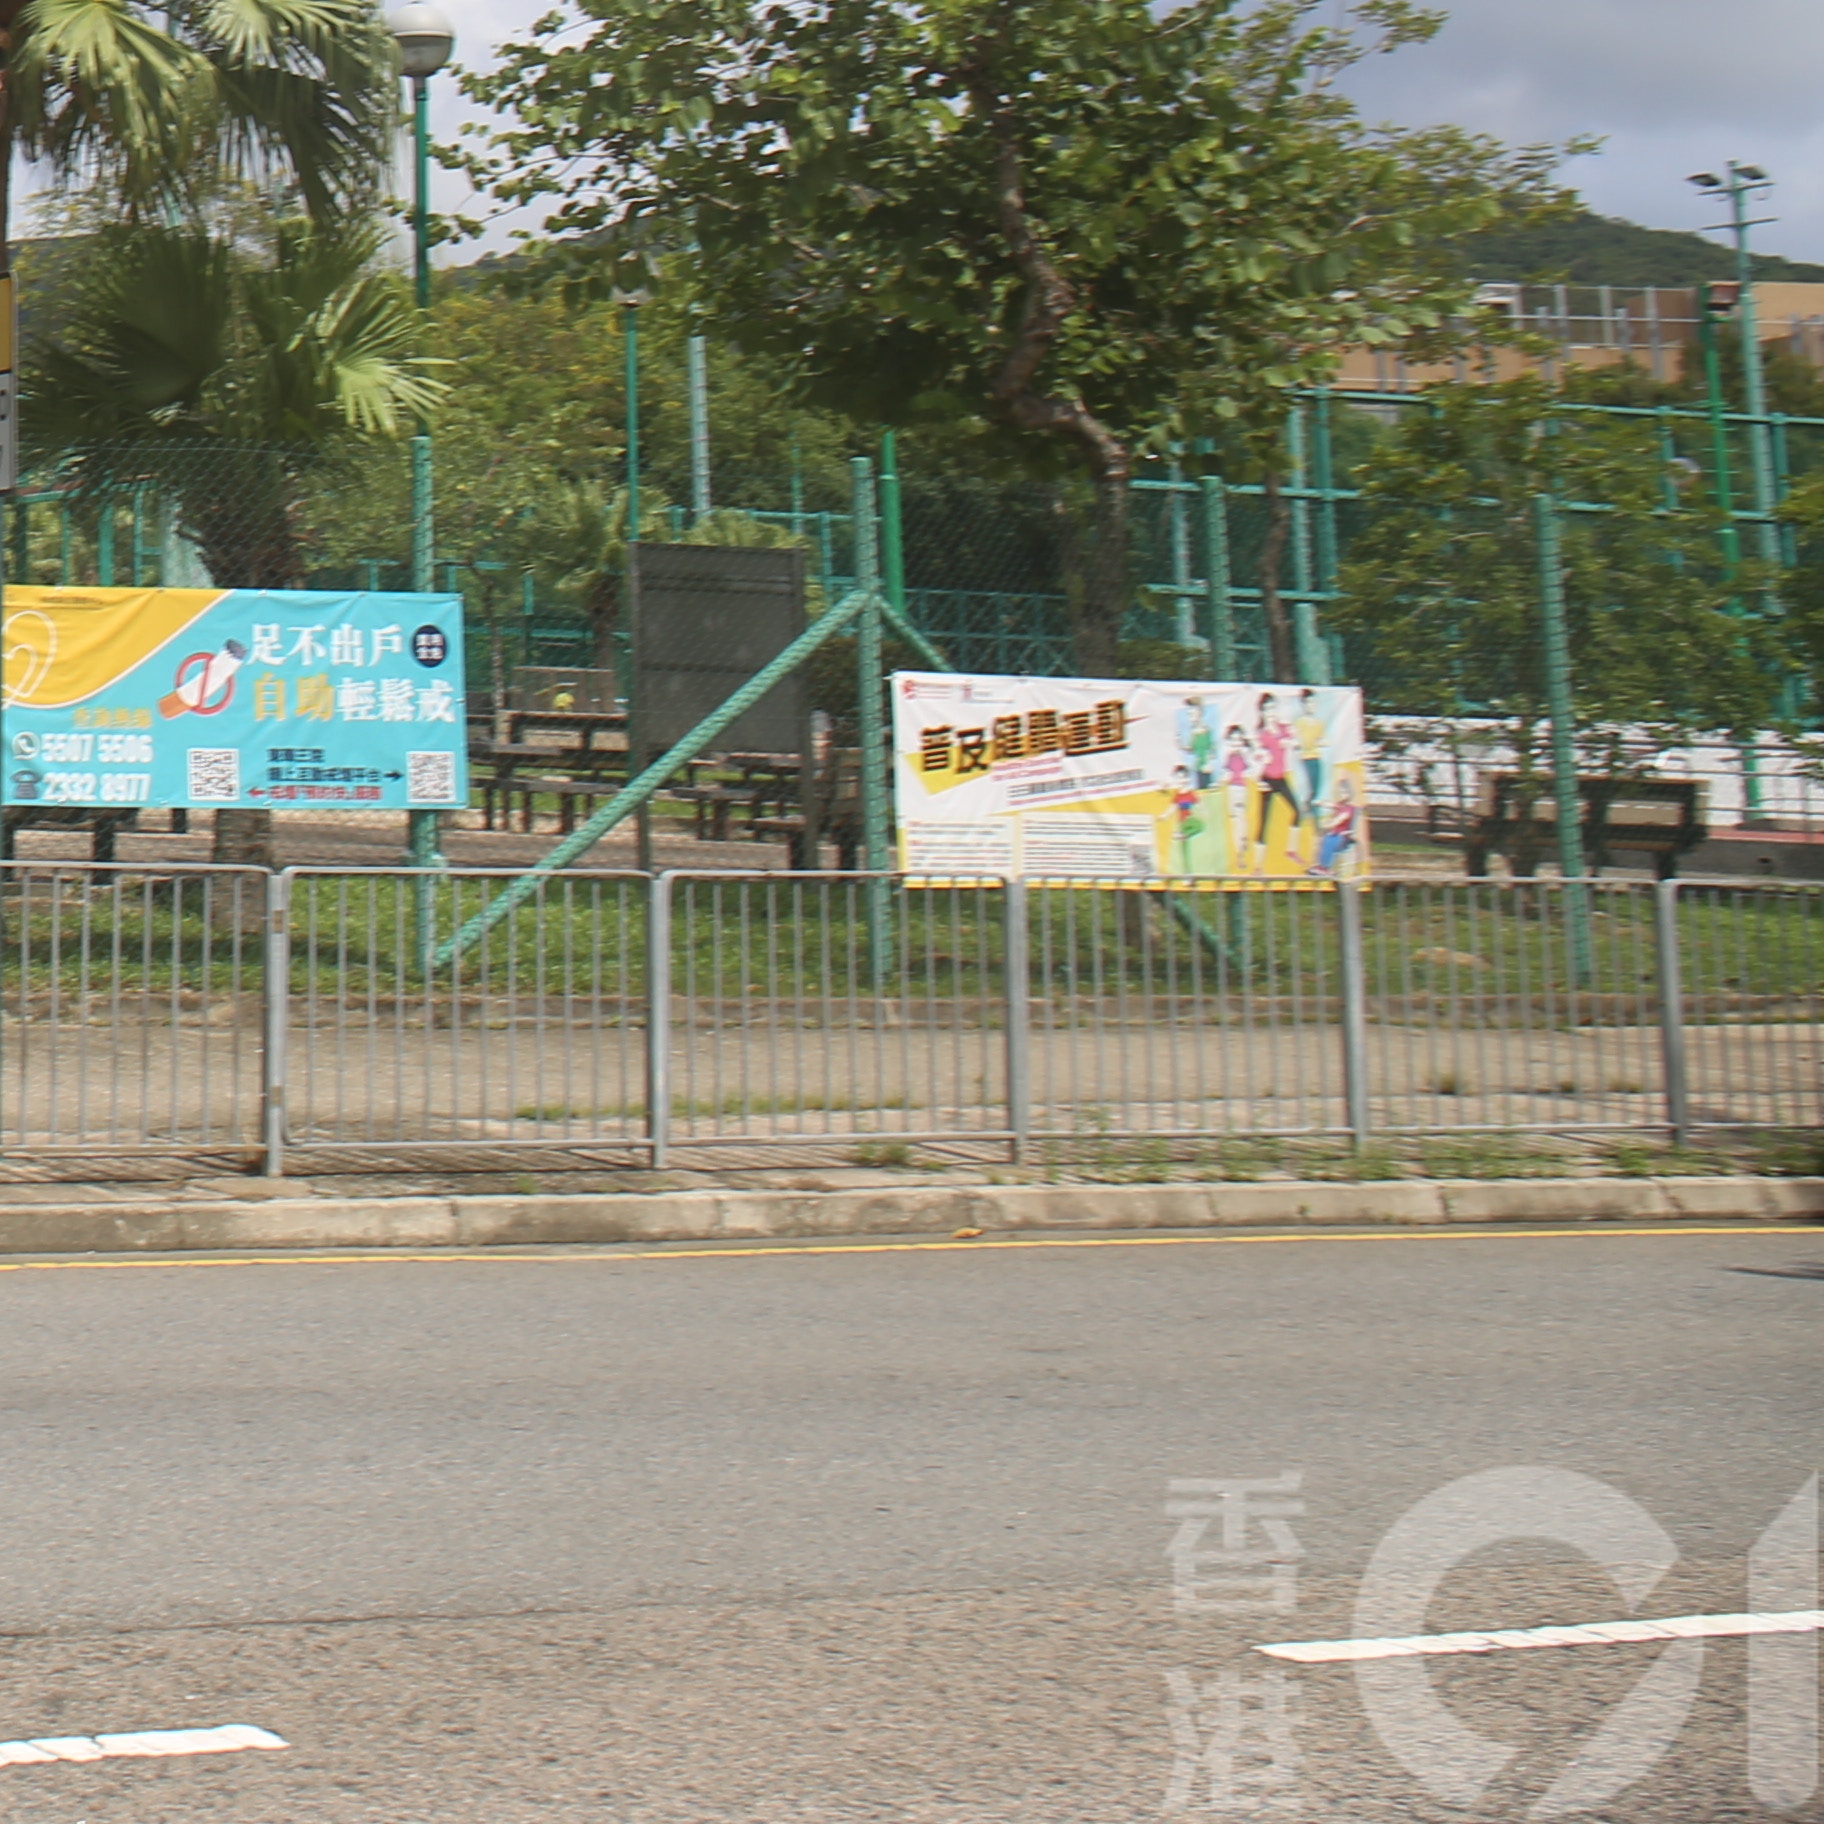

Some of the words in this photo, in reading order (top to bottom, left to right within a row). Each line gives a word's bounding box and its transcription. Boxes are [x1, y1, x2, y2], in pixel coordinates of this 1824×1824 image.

[246, 623, 404, 667] 足不出戶
[42, 771, 98, 802] 2332
